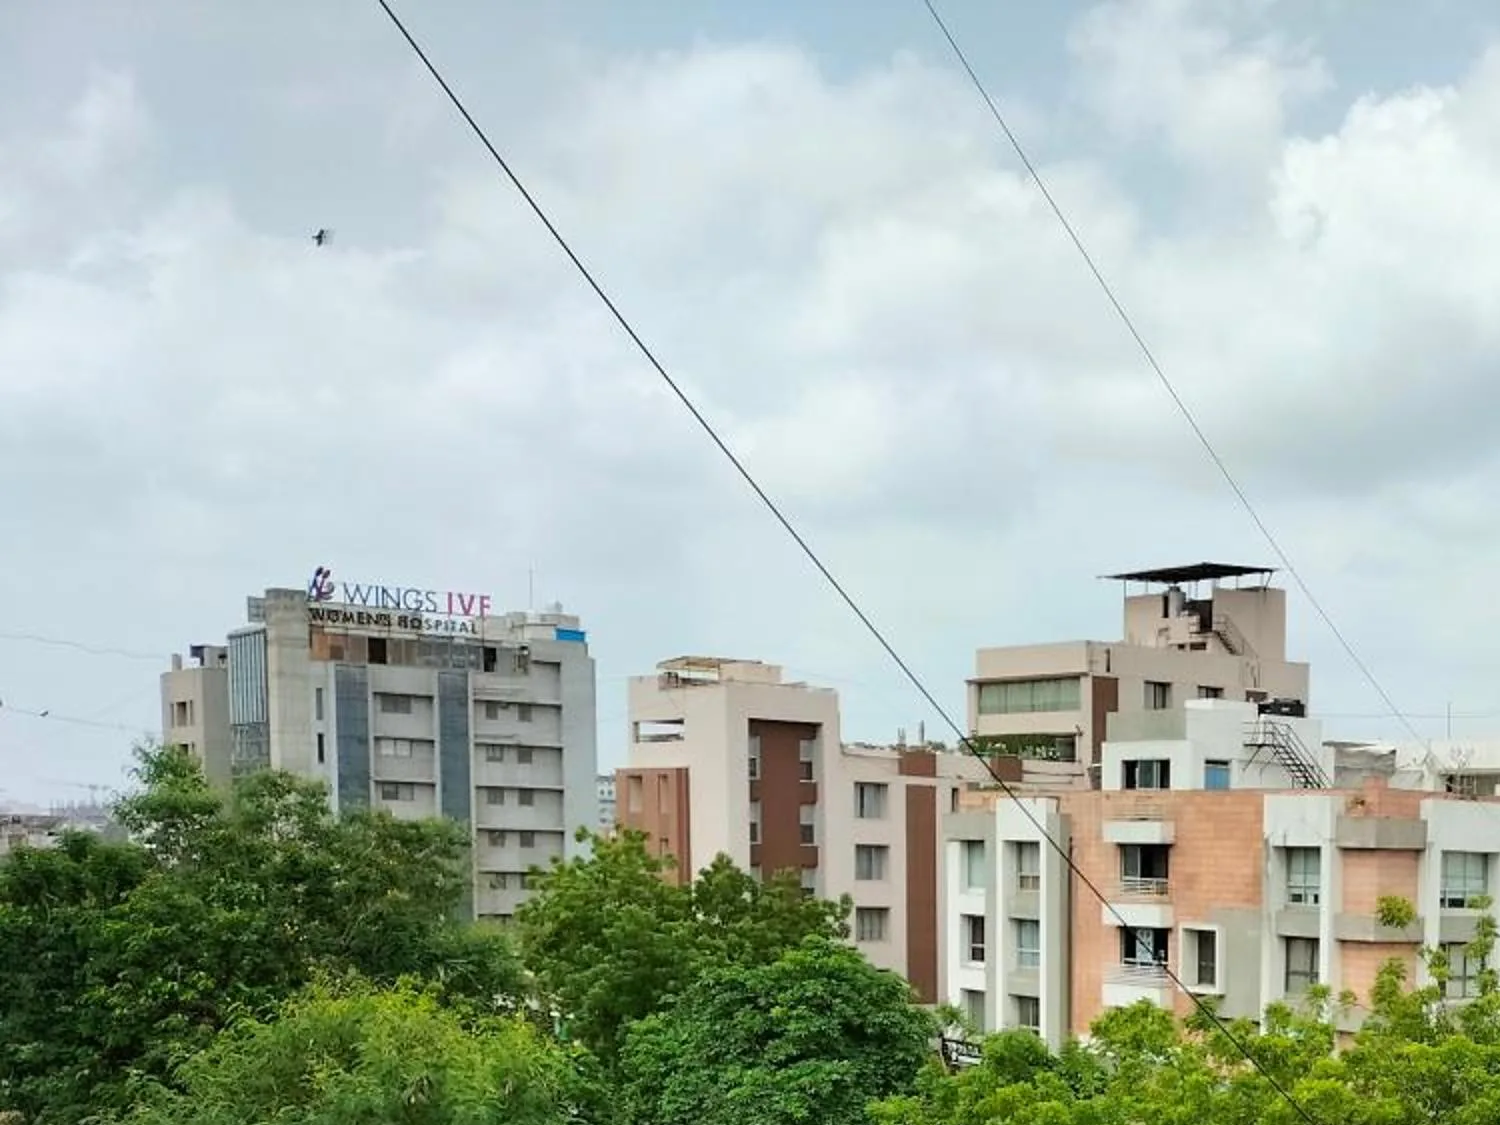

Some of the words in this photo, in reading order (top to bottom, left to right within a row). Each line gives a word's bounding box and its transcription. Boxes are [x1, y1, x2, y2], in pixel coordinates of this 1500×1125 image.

[343, 582, 437, 613] WINGS
[447, 591, 491, 617] IVF
[398, 615, 479, 635] HOSPITAL
